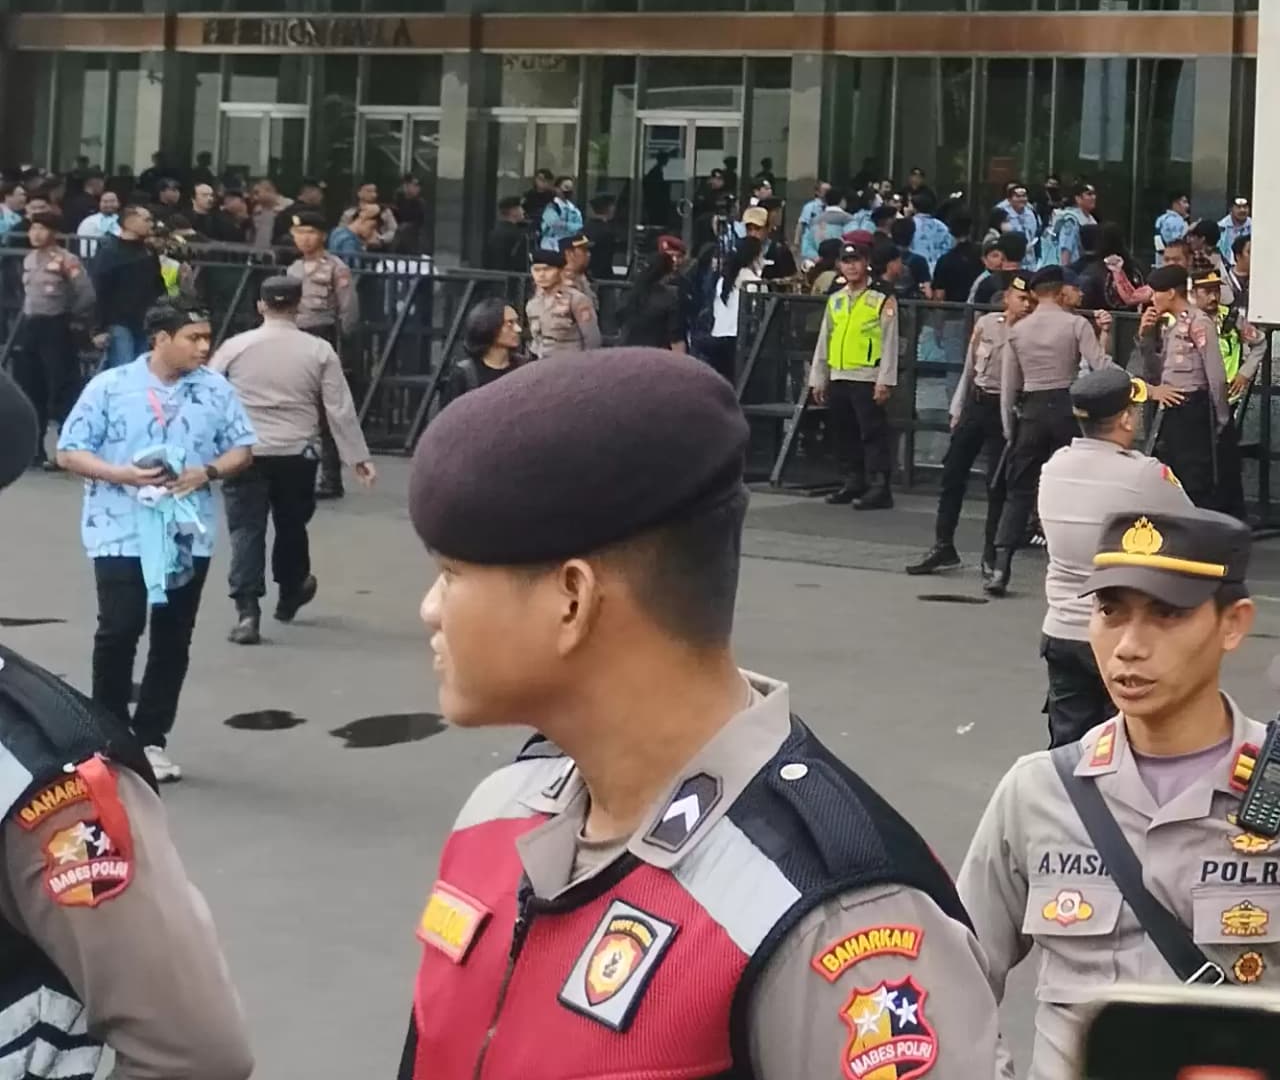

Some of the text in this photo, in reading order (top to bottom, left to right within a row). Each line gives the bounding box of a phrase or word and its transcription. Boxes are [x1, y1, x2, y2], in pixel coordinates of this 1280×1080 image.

[822, 928, 916, 972] BAHARKAM
[851, 1040, 933, 1076] MABES POLRI
